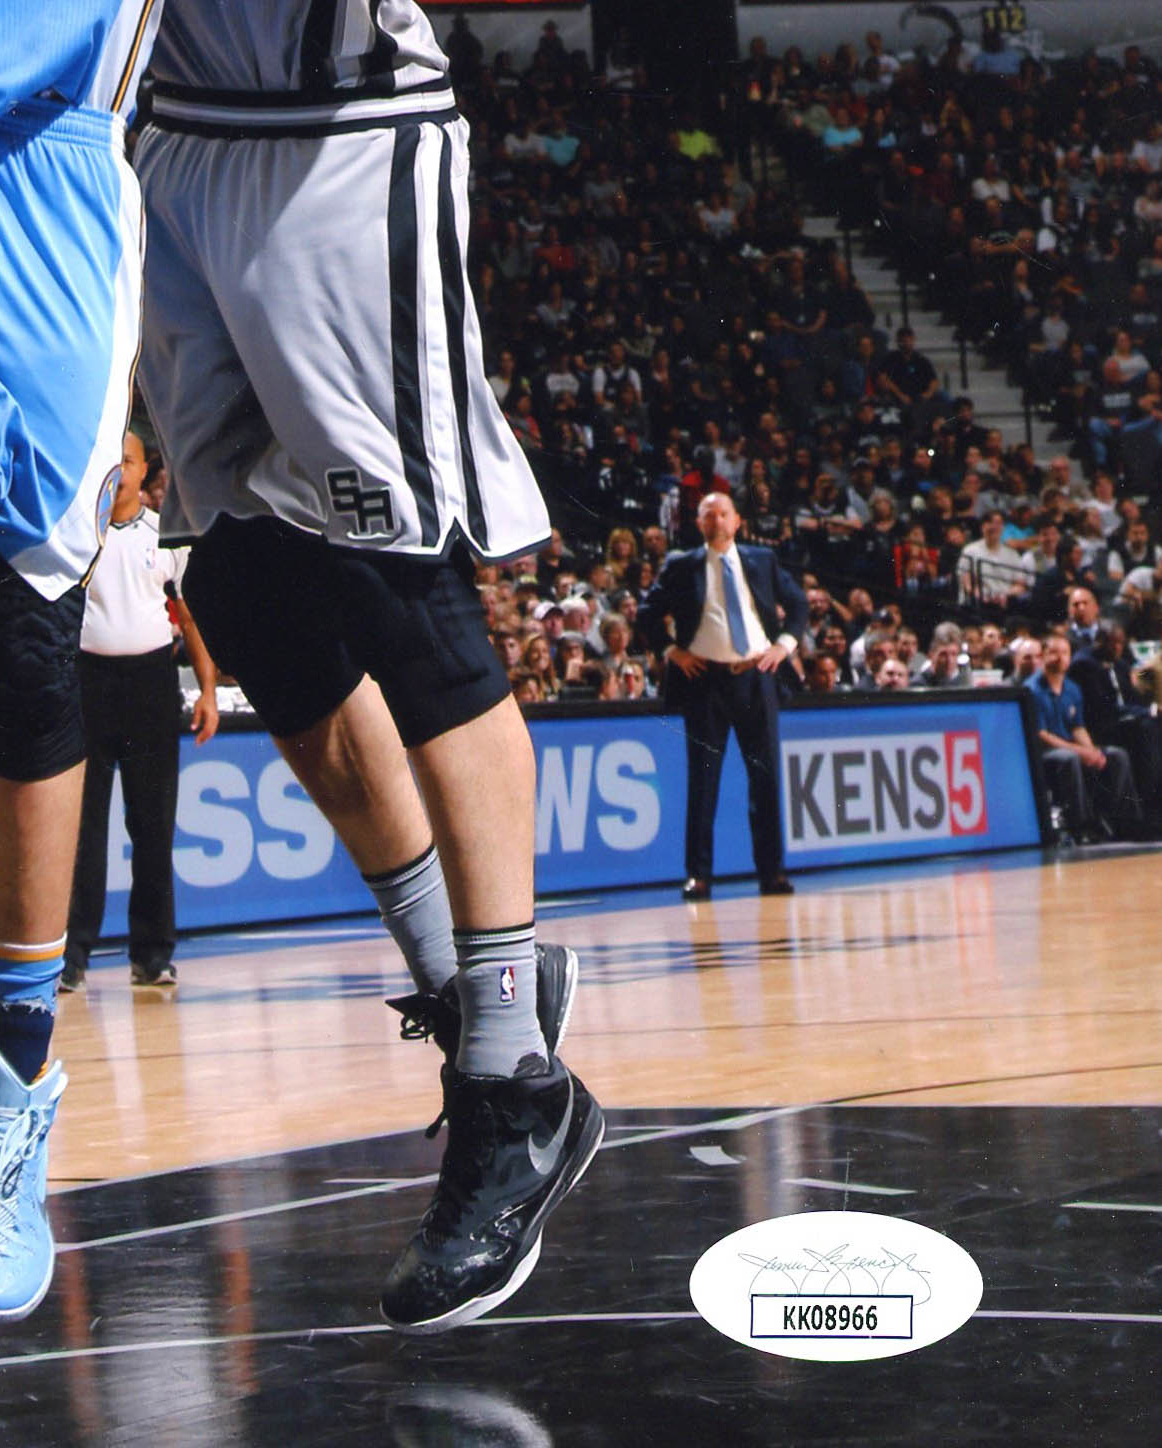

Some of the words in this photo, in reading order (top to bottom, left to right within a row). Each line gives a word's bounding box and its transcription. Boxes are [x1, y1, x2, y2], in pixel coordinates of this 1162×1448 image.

[984, 8, 1025, 30] 112
[788, 745, 946, 840] KENS
[950, 736, 984, 830] 5
[783, 1304, 878, 1331] KK08966
